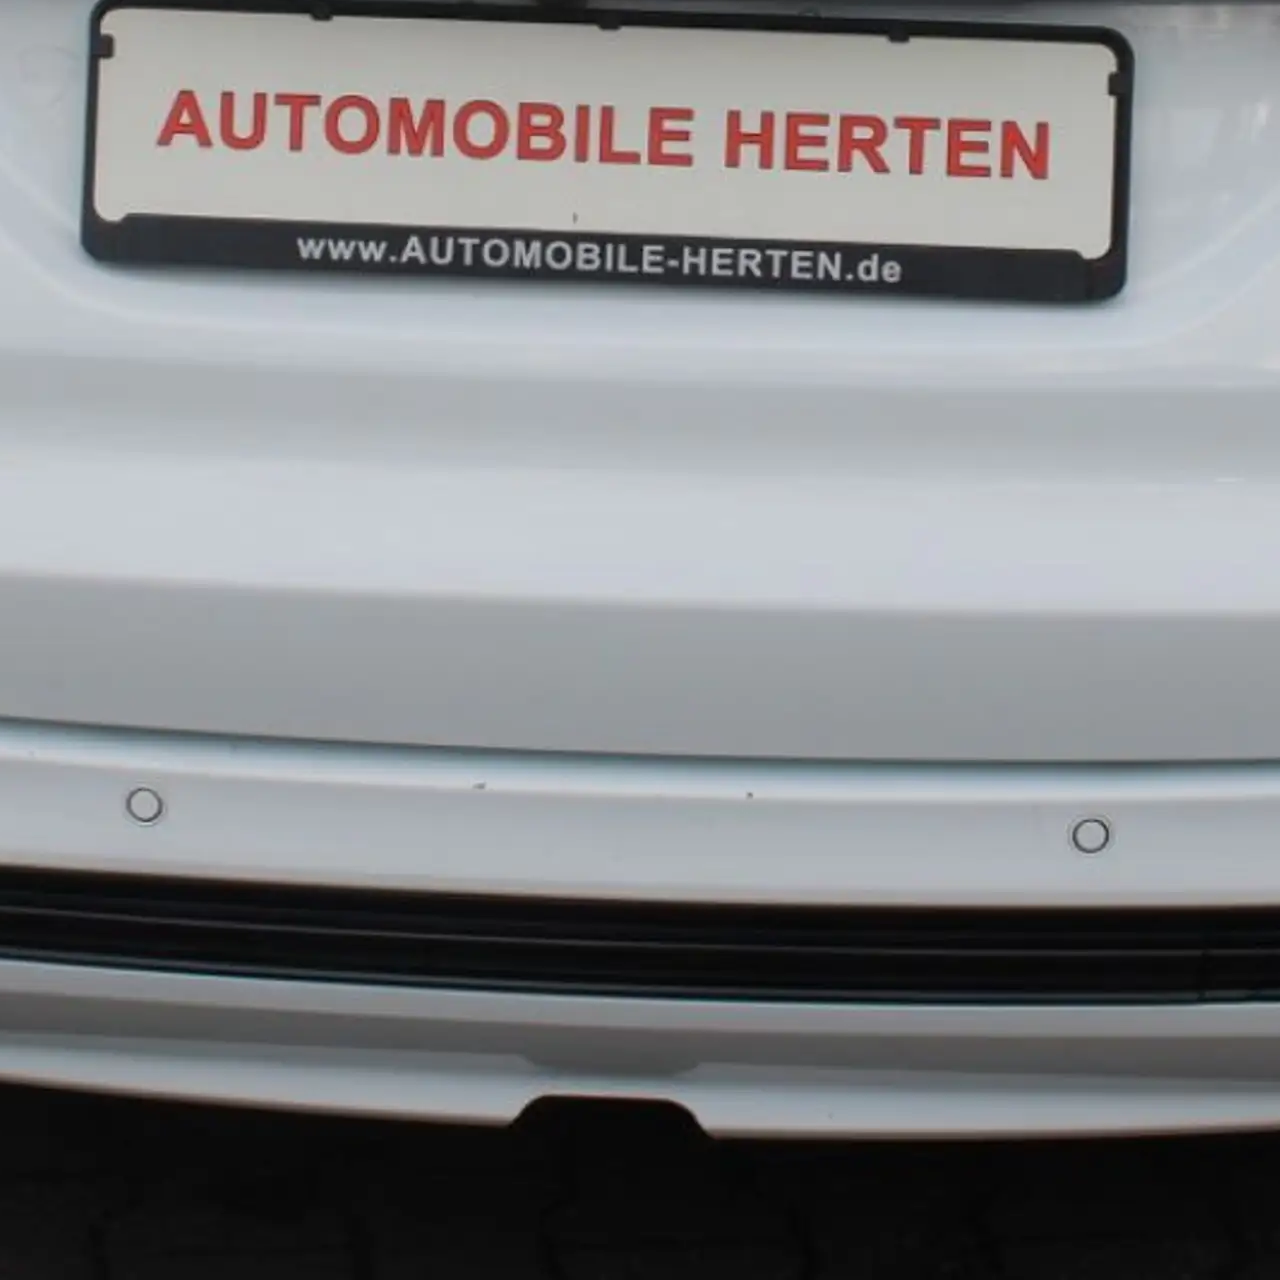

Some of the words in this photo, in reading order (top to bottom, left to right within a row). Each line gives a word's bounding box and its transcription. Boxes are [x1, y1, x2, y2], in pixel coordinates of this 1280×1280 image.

[156, 89, 694, 167] AUTOMOBILE
[723, 109, 1051, 180] HERTEN
[296, 235, 902, 283] www.AUTOMOBILE-HERTEN.de
